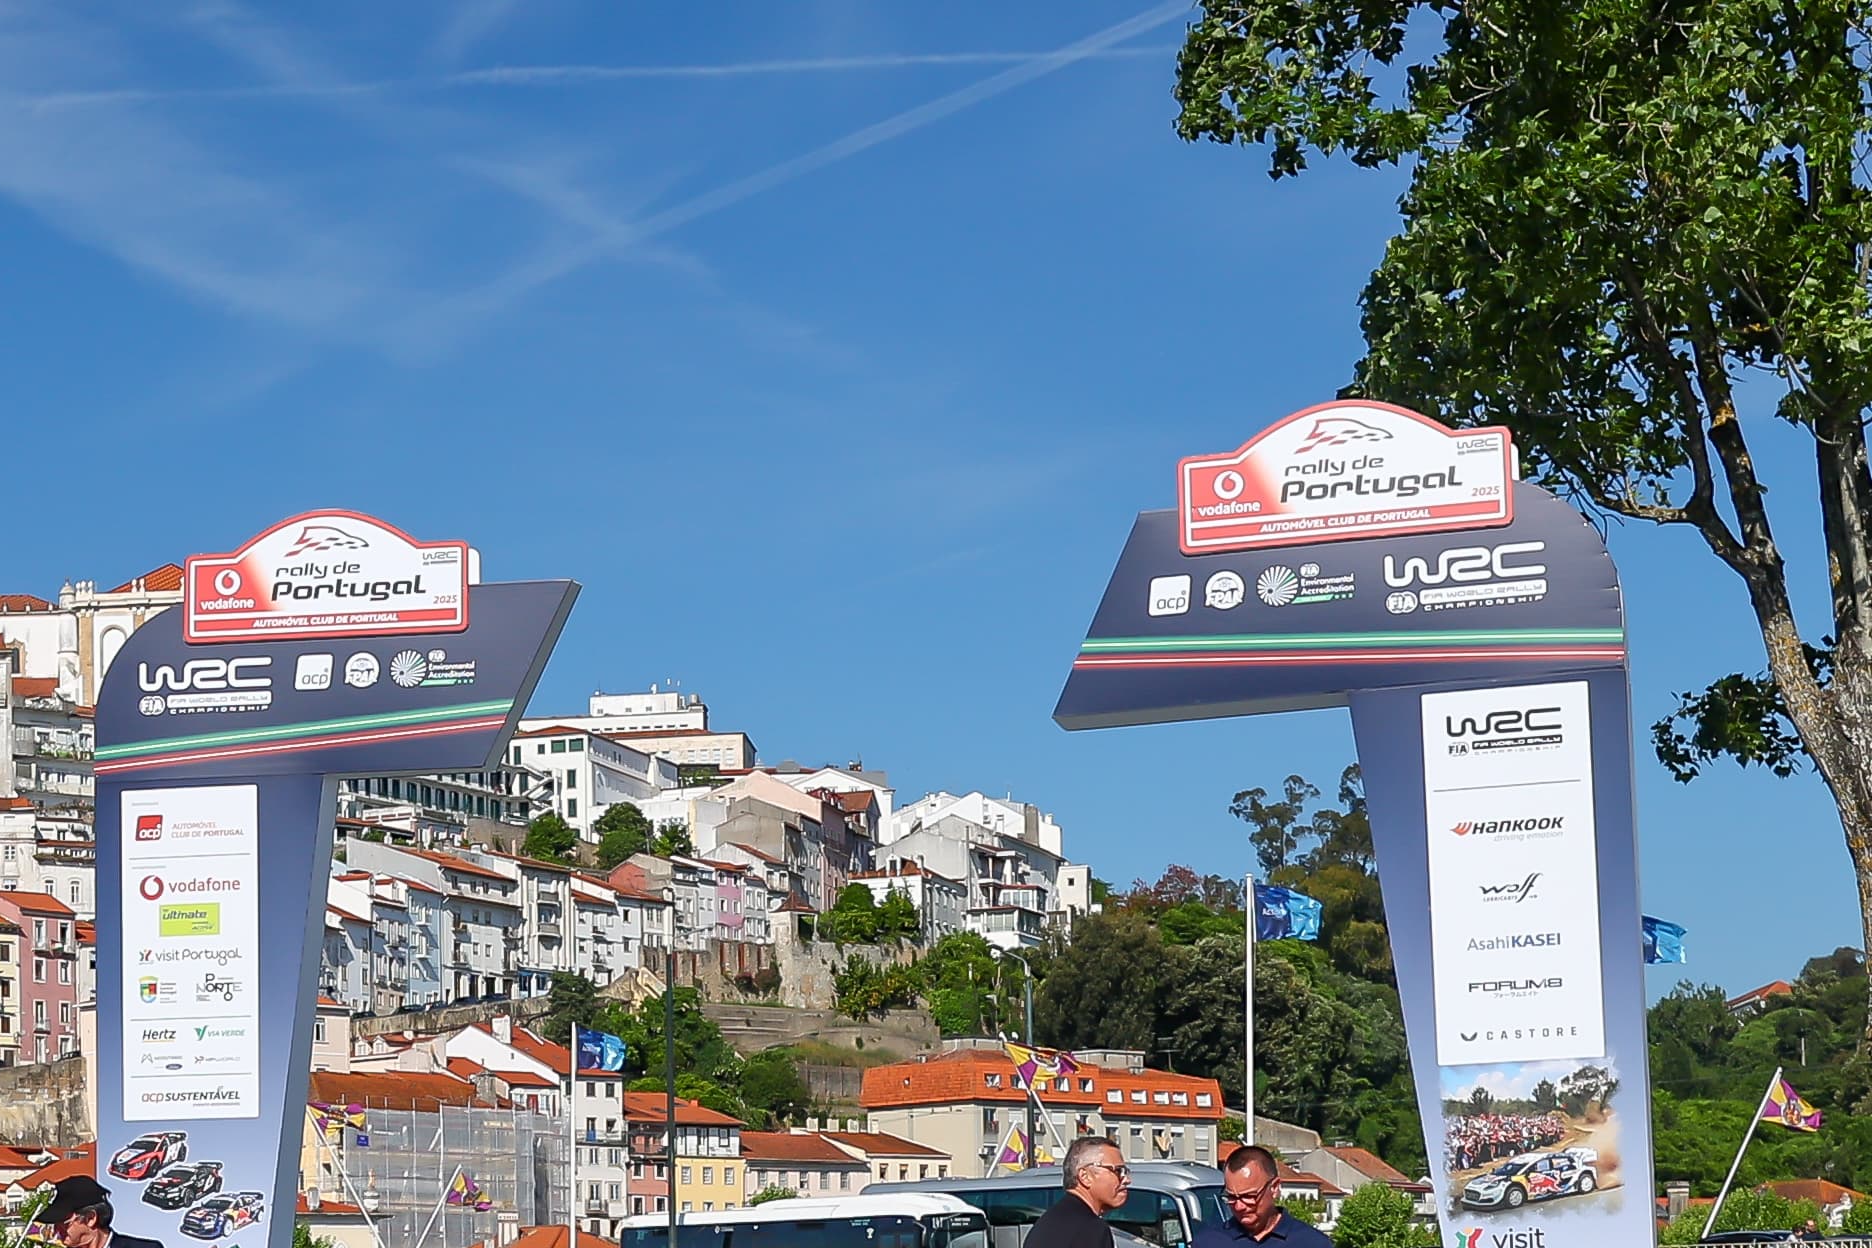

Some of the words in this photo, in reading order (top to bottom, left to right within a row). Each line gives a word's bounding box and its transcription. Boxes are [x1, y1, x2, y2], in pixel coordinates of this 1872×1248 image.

[1284, 458, 1346, 476] rally
[1351, 455, 1384, 471] de
[1280, 465, 1463, 503] Portugal
[1471, 485, 1501, 497] 2025
[1198, 500, 1261, 516] vodafone
[1260, 517, 1326, 533] AUTOMÓVEL
[1327, 515, 1356, 528] CLUB
[1356, 513, 1371, 525] DE
[1372, 508, 1431, 523] PORTUGAL
[275, 562, 328, 580] rally
[332, 561, 361, 574] de
[1383, 540, 1547, 588] WRC
[271, 574, 426, 602] Portugal
[200, 597, 255, 611] vodafone
[432, 594, 458, 605] 2025
[1156, 595, 1186, 611] acp
[1423, 594, 1545, 611] CHAMPIONSHIP
[253, 614, 310, 628] AUTOMÓVEL
[311, 615, 335, 626] CLUB
[335, 614, 348, 624] DE
[349, 612, 399, 623] PORTUGAL
[138, 656, 273, 693] WRC
[301, 672, 329, 687] acp
[1446, 706, 1563, 738] WRC
[138, 827, 161, 840] acp
[203, 828, 245, 838] PORTUGAL
[168, 876, 241, 893] vodafone
[162, 909, 207, 920] ultimate
[155, 948, 180, 962] visit
[181, 947, 243, 967] Portugal
[1468, 977, 1563, 993] FORUM8
[142, 1028, 177, 1041] Hertz
[1486, 1026, 1578, 1041] CASTORE
